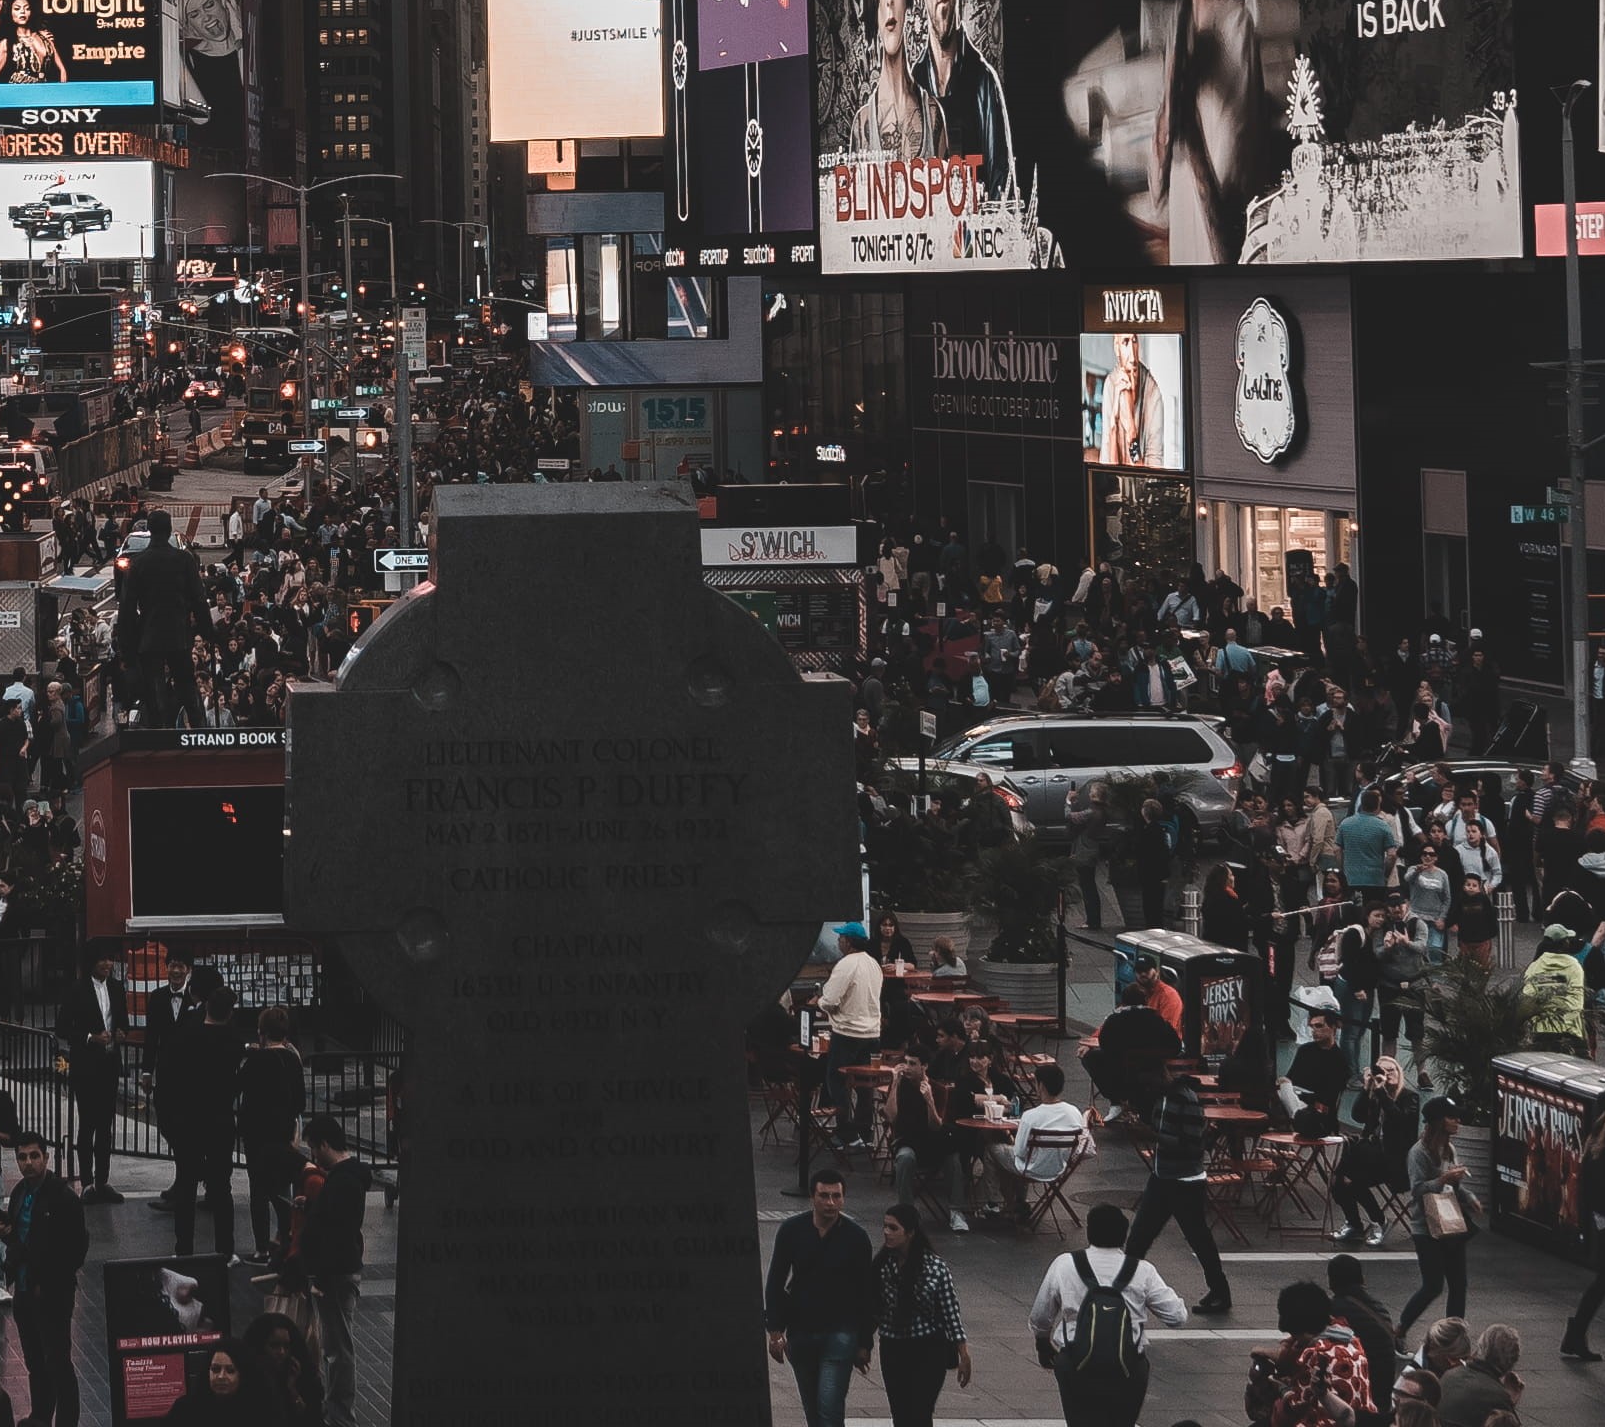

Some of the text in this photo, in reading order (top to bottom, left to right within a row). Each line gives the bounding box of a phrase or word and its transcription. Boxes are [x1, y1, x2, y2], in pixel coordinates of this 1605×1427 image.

[115, 18, 136, 30] FOX
[570, 27, 648, 42] #JUSTSMILE
[72, 41, 146, 65] Empire
[21, 108, 101, 125] SONY
[835, 153, 983, 224] BLINDSPOT
[851, 230, 1005, 263] TONIGHT NBC
[1102, 288, 1163, 325] INVICTA
[932, 321, 1059, 386] Brookstone
[932, 395, 1060, 419] OPENING OCTOBER 2016
[395, 554, 413, 566] ONE
[180, 732, 277, 747] STRAND BOOK
[402, 772, 748, 813] FRANCIS DUFFY
[1202, 979, 1245, 1007] JERSEY
[1209, 1002, 1238, 1024] BOYS
[141, 1335, 161, 1347] NOW
[162, 1333, 198, 1346] PLAYING
